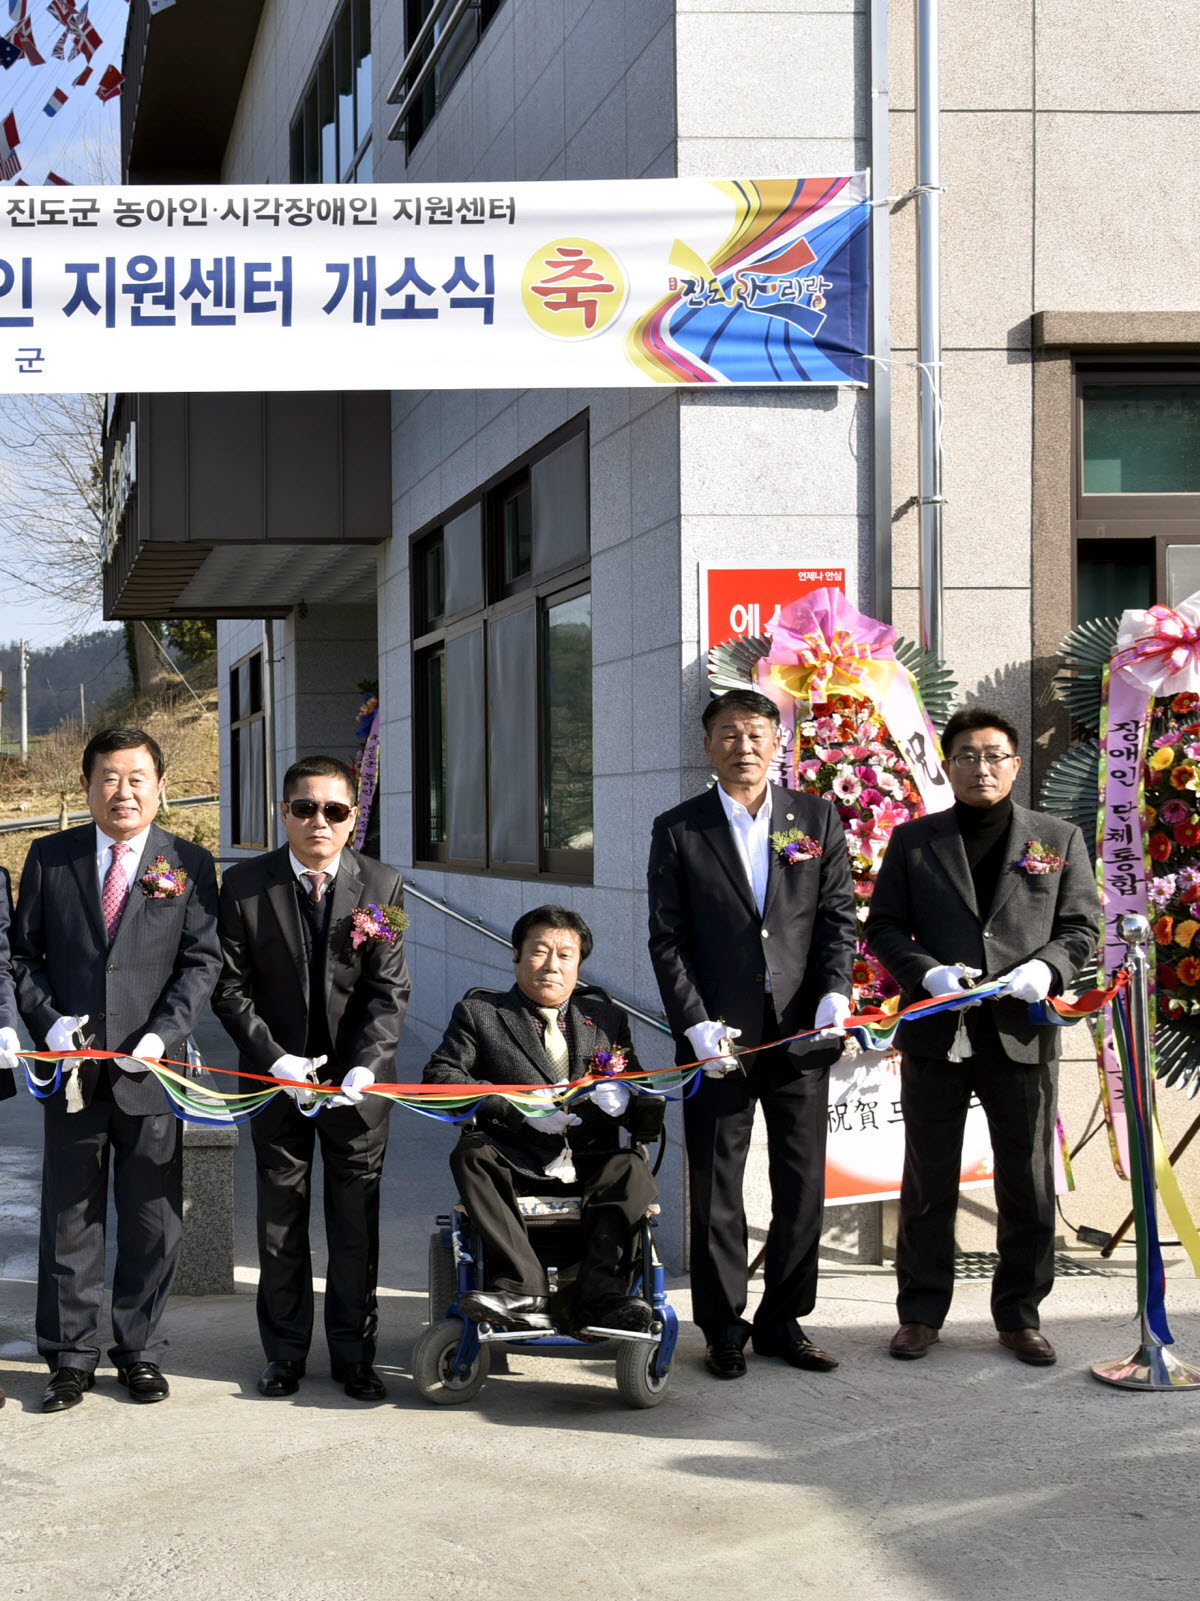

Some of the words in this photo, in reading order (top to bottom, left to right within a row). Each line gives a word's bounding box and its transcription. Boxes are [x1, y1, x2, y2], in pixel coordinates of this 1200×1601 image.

[6, 198, 101, 228] 진도군
[113, 197, 378, 228] 농아인·시각장애인
[392, 196, 516, 226] 지원센터
[62, 255, 293, 329] 지원센터
[322, 254, 495, 327] 개소식
[530, 247, 616, 330] 축
[797, 571, 824, 582] 언제나
[825, 571, 843, 582] 안심
[1108, 719, 1145, 788] 장애인
